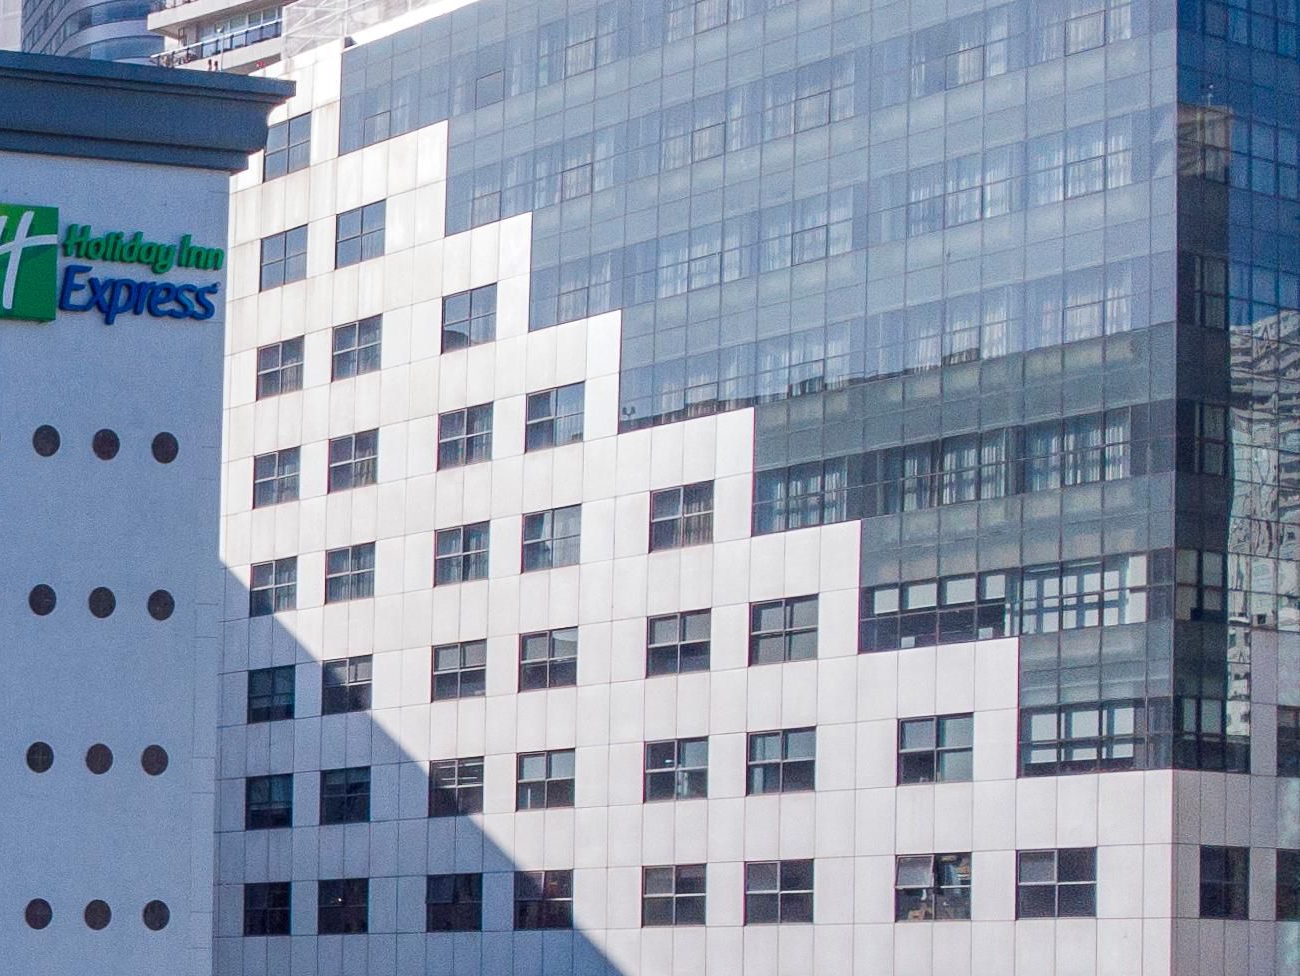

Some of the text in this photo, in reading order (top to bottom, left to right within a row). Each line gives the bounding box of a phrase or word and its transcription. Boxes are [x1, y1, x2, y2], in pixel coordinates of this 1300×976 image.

[62, 222, 225, 274] Holiday Inn
[59, 264, 220, 325] Express
